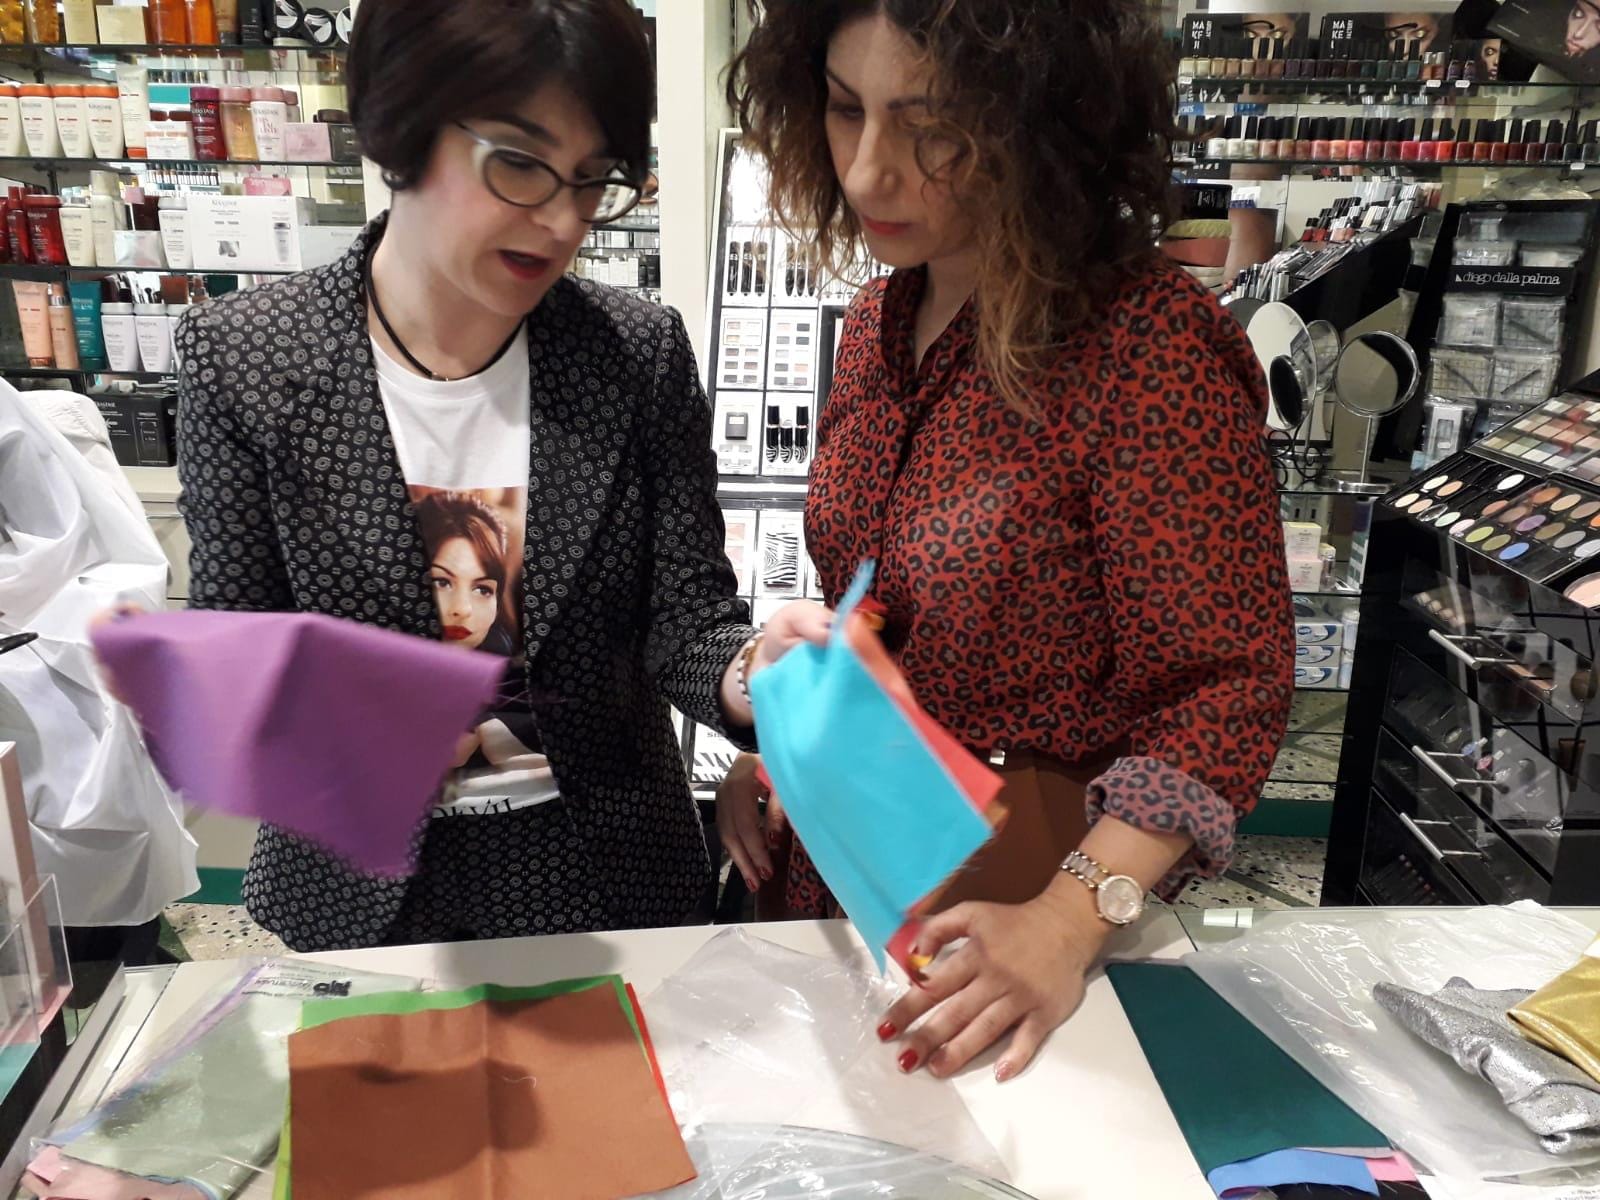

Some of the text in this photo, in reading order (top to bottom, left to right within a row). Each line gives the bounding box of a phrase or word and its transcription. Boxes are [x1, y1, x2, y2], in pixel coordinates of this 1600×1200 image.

[1192, 20, 1205, 30] MA
[1332, 20, 1346, 30] MA
[1331, 30, 1344, 39] KE
[1463, 271, 1561, 287] diego dalla palma
